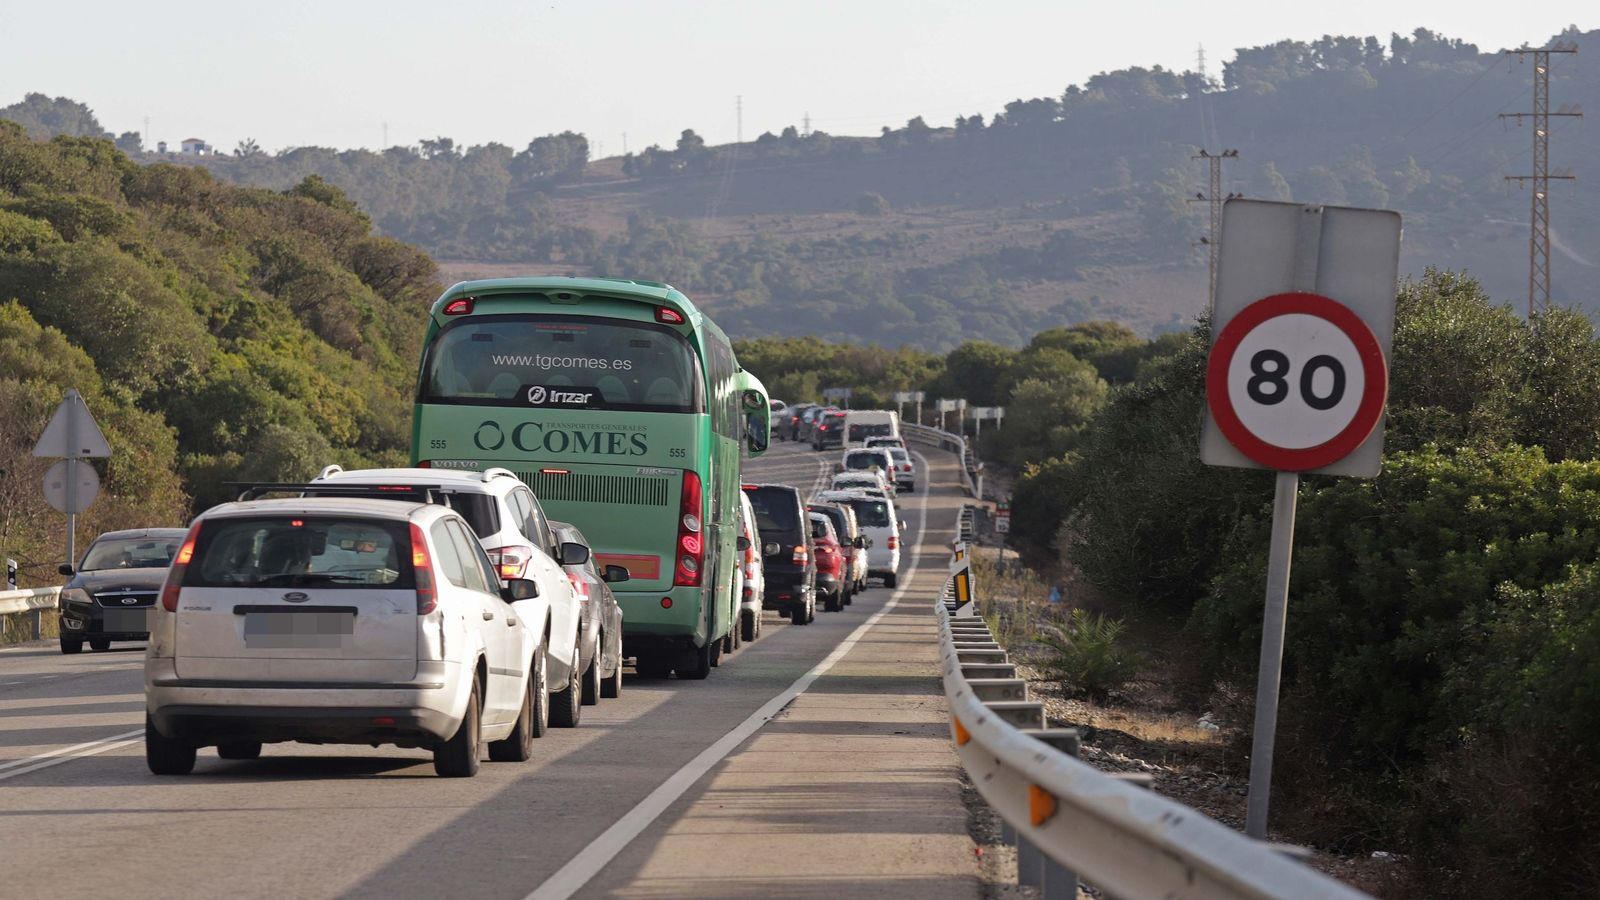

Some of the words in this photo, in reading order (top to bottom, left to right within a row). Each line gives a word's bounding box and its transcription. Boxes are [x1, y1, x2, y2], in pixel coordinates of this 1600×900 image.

[492, 354, 632, 370] www.tgcomes.es
[1247, 349, 1346, 410] 80
[550, 390, 593, 403] Irizar
[546, 422, 600, 430] TRANSPORTES
[430, 439, 447, 449] 555
[511, 421, 648, 456] COMES
[669, 448, 686, 458] 555
[434, 460, 478, 468] VOLVO
